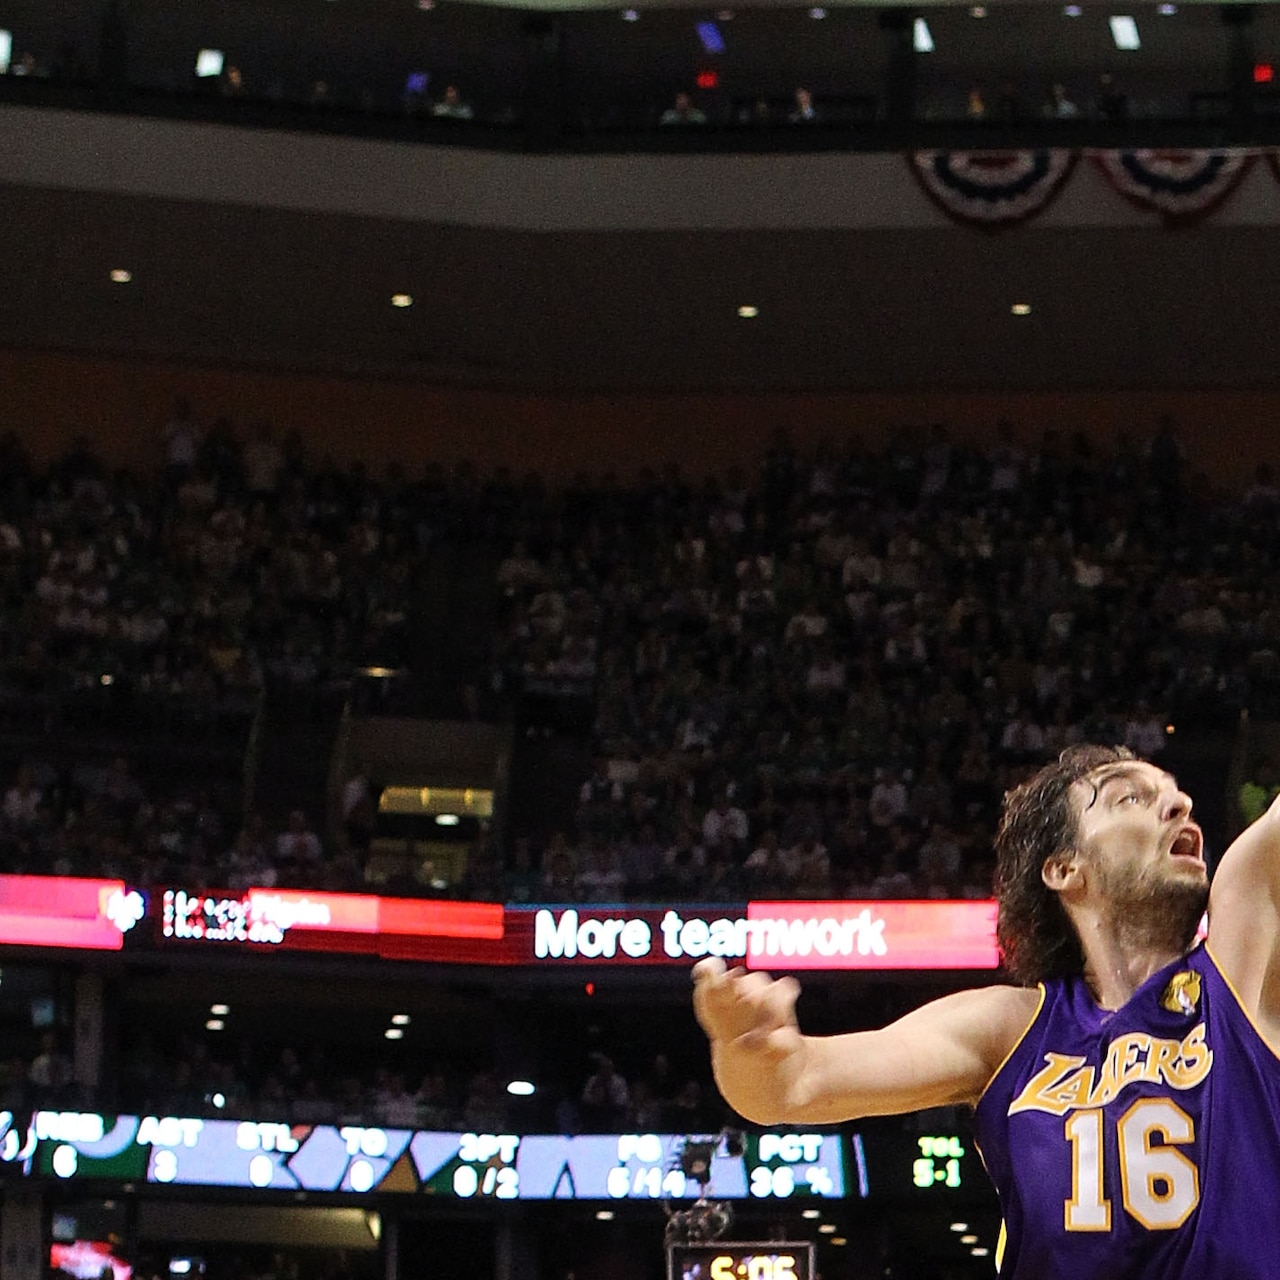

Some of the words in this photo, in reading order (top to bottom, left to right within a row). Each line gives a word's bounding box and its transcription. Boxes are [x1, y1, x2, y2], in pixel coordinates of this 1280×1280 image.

[535, 908, 651, 958] More
[661, 909, 888, 958] teamwork
[1007, 1022, 1213, 1117] LAKERS
[136, 1116, 204, 1147] AST
[236, 1121, 299, 1152] STL
[340, 1126, 388, 1157] TO
[759, 1134, 823, 1162] PCT
[1064, 1097, 1200, 1232] 16
